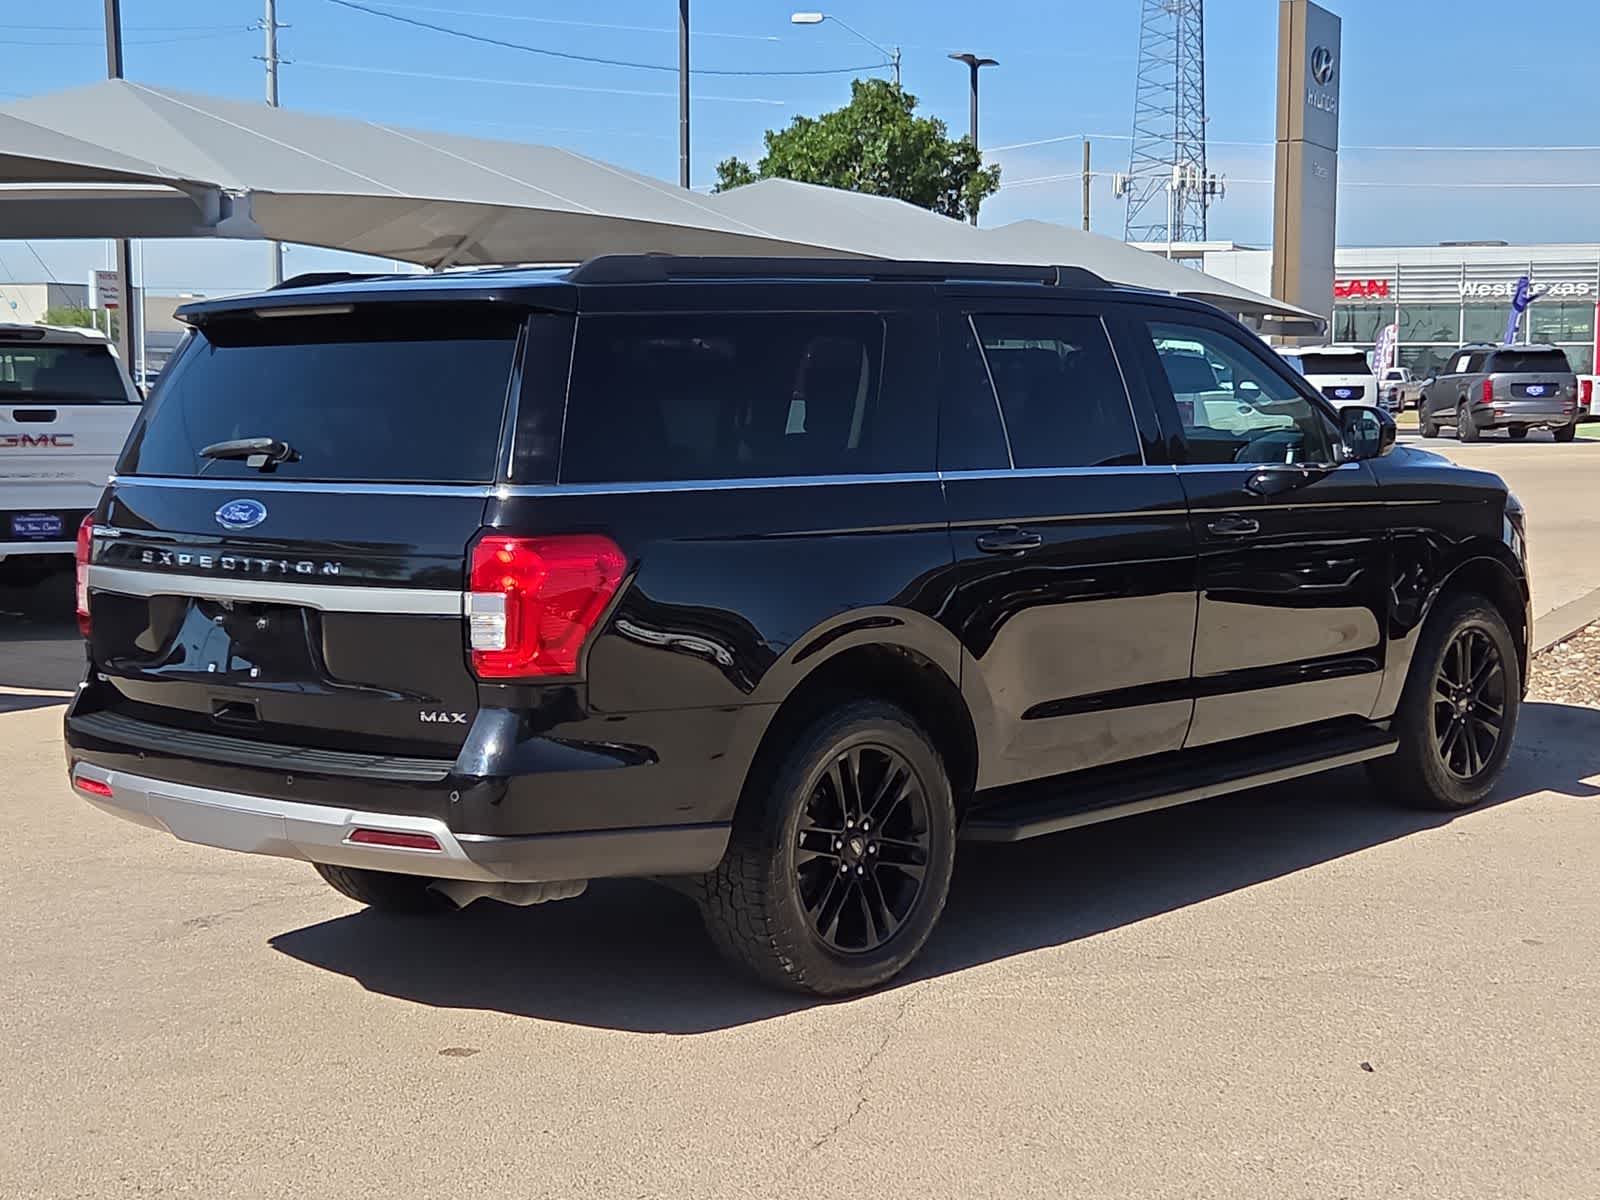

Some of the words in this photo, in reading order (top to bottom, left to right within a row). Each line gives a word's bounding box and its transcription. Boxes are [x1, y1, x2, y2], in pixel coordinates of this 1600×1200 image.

[1457, 281, 1516, 296] West
[1529, 280, 1590, 297] exas
[0, 433, 74, 447] GMC
[141, 550, 341, 575] EXPEDITION
[420, 711, 467, 724] MAX
